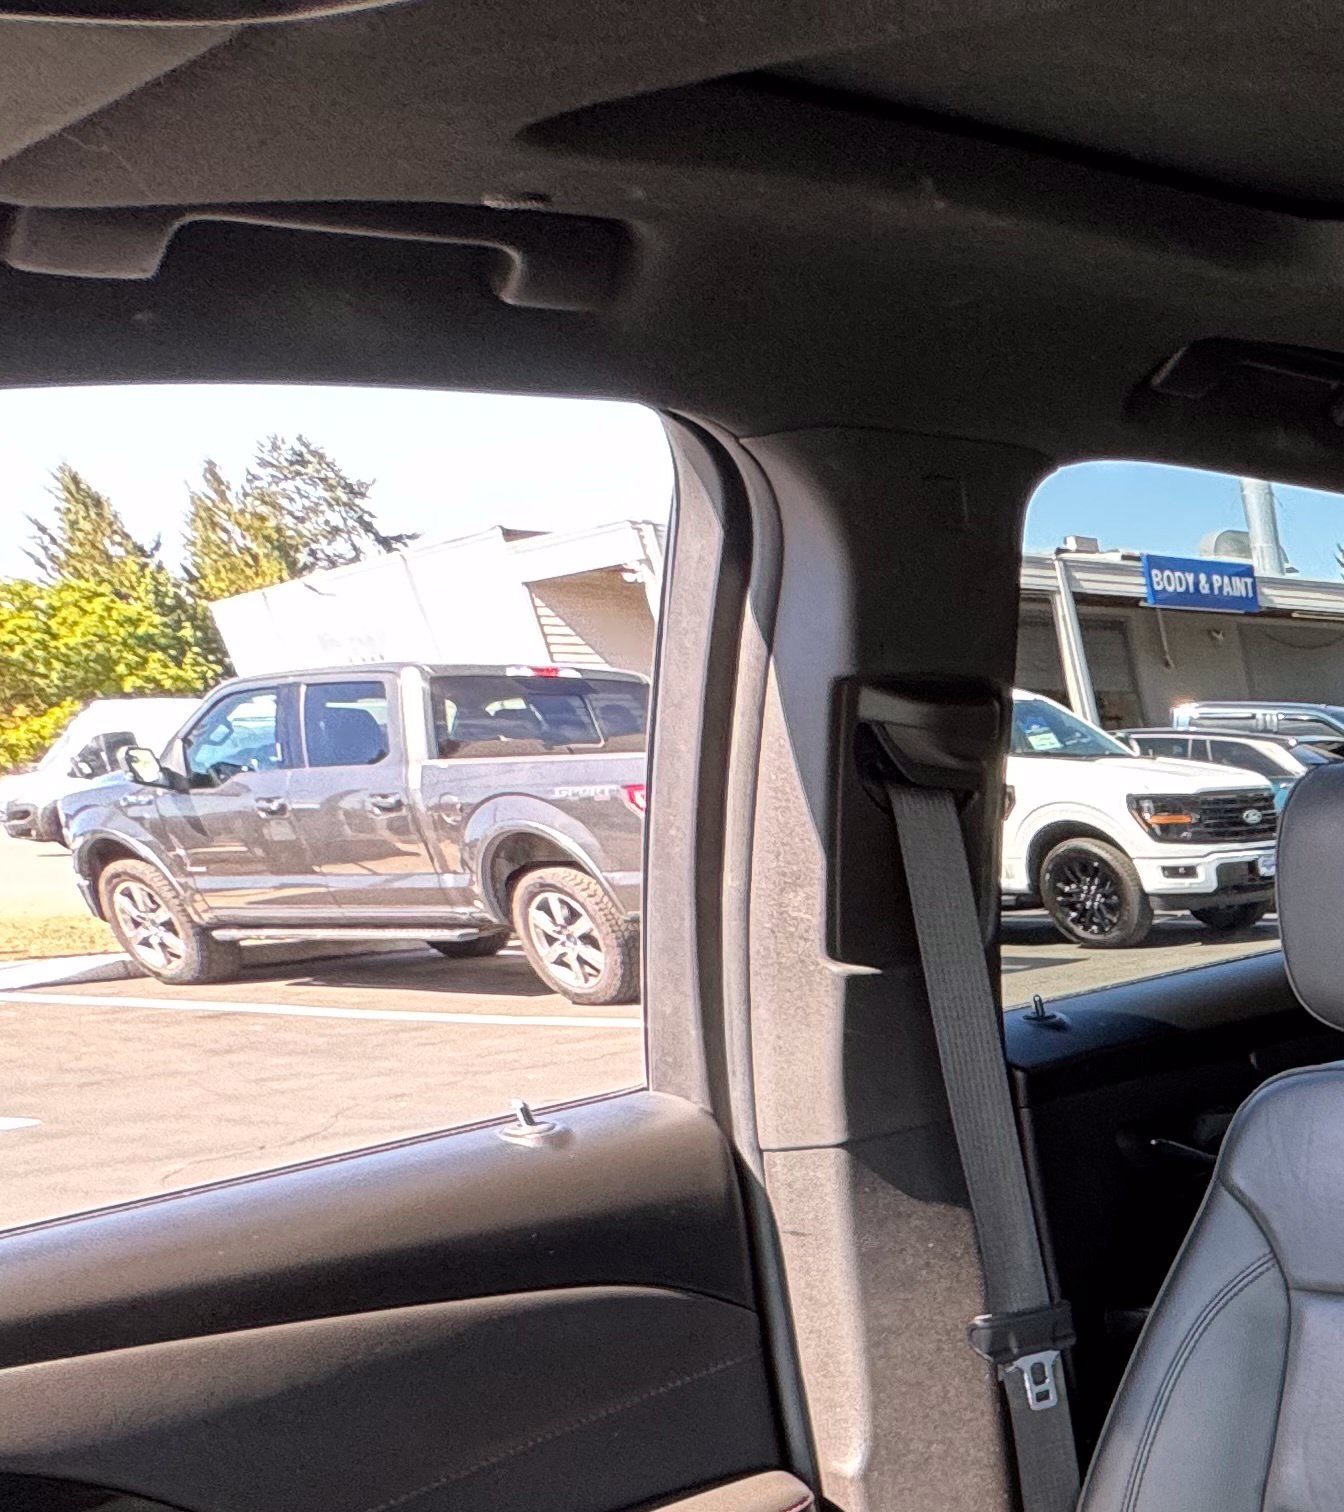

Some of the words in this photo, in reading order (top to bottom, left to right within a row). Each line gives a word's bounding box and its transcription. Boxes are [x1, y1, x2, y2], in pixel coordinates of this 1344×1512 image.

[1151, 569, 1195, 594] BODY
[1199, 573, 1210, 594] &
[1212, 574, 1254, 598] PAINT
